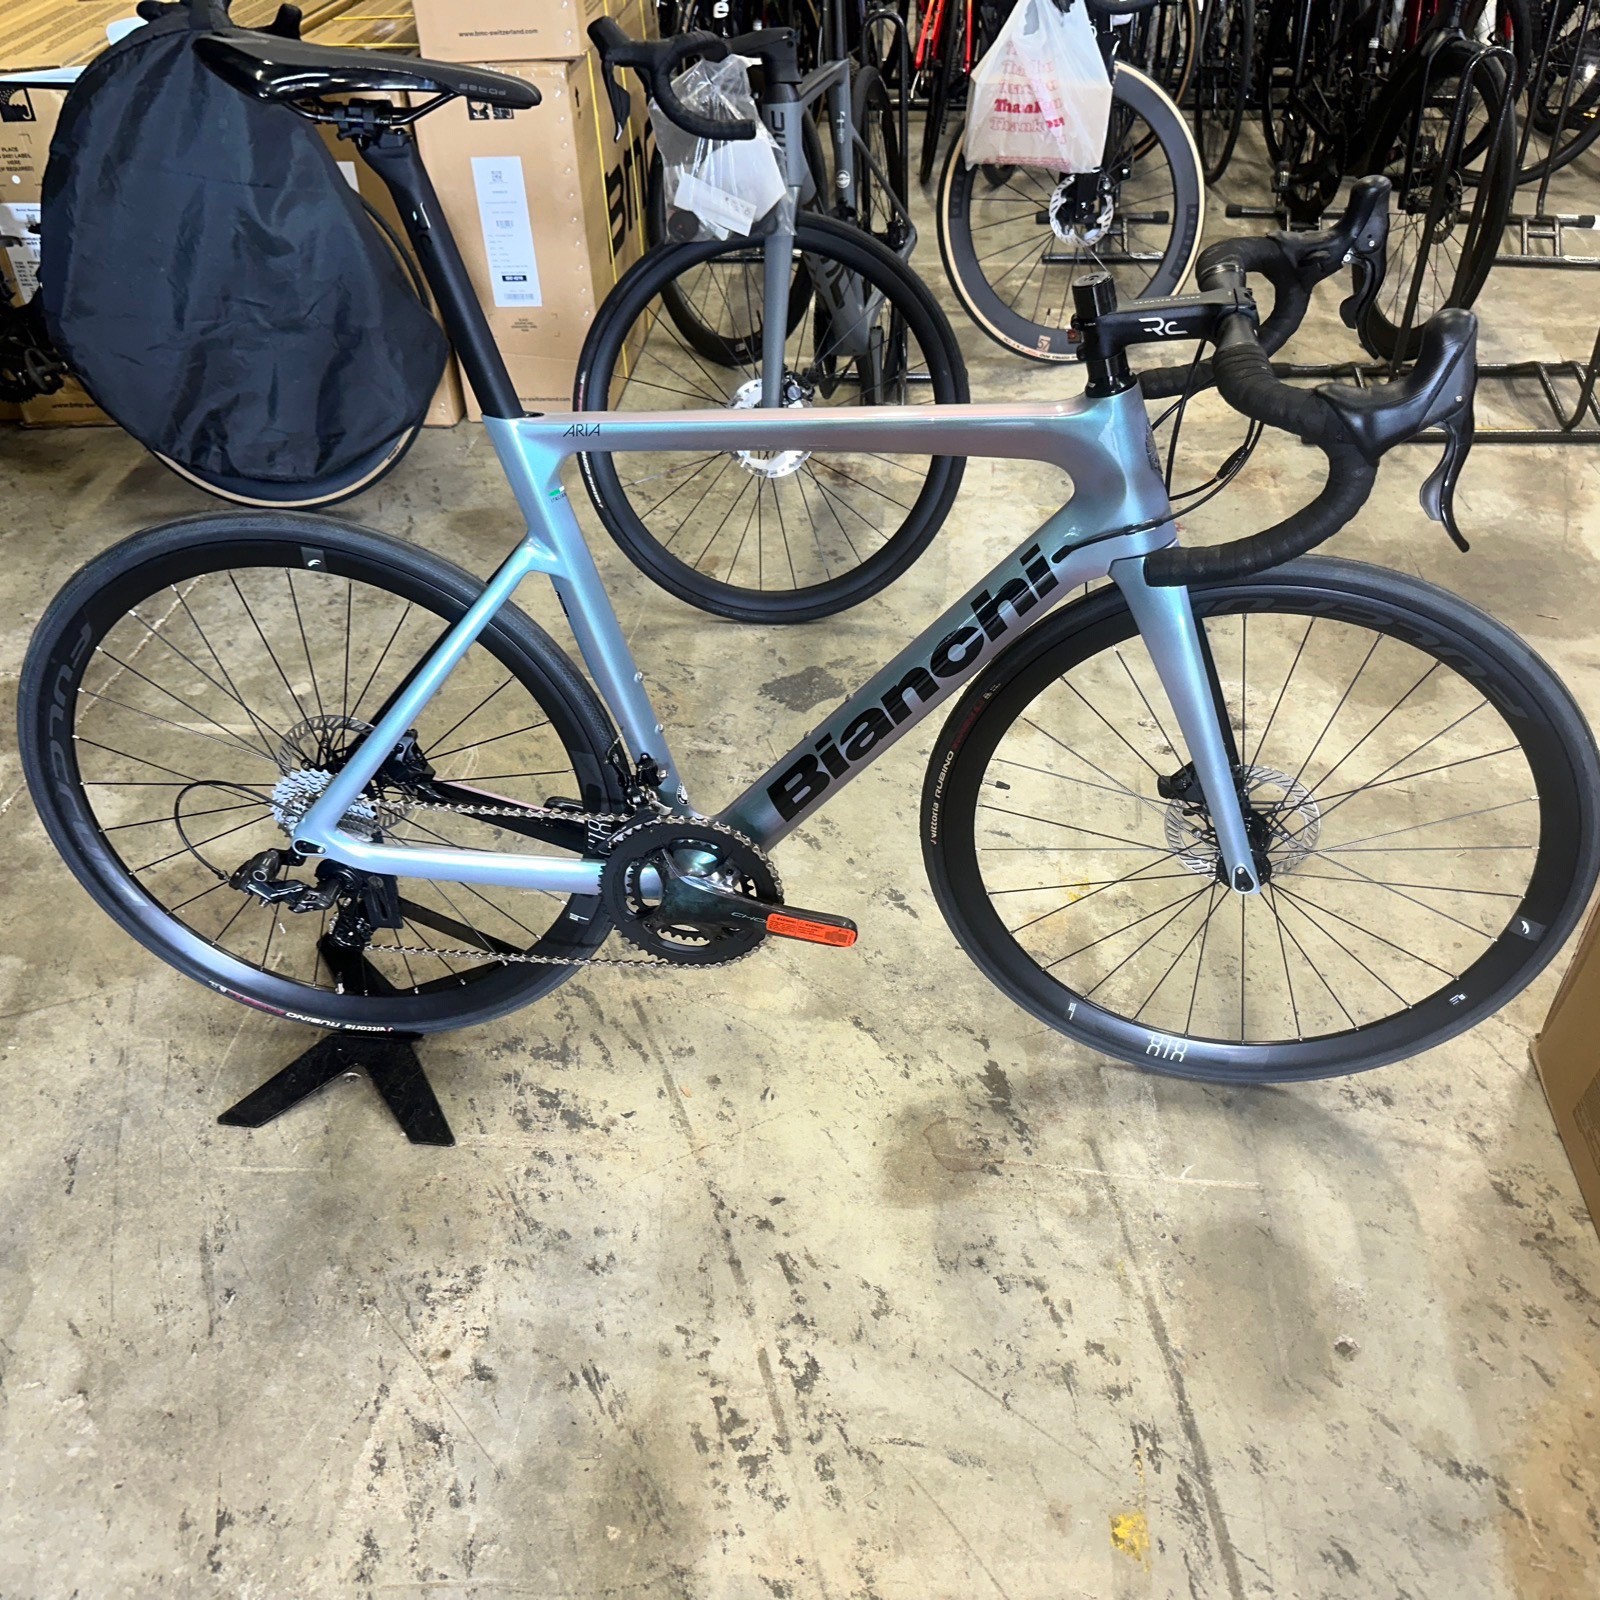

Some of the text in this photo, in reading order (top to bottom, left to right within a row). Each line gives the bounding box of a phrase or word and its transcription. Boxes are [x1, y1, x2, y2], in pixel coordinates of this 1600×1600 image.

[458, 29, 538, 37] www.bmc-switzerland.com
[562, 423, 600, 437] ARIA
[766, 543, 1059, 822] Bianchi
[934, 751, 954, 799] RUBINO
[286, 1011, 339, 1028] RUBINO
